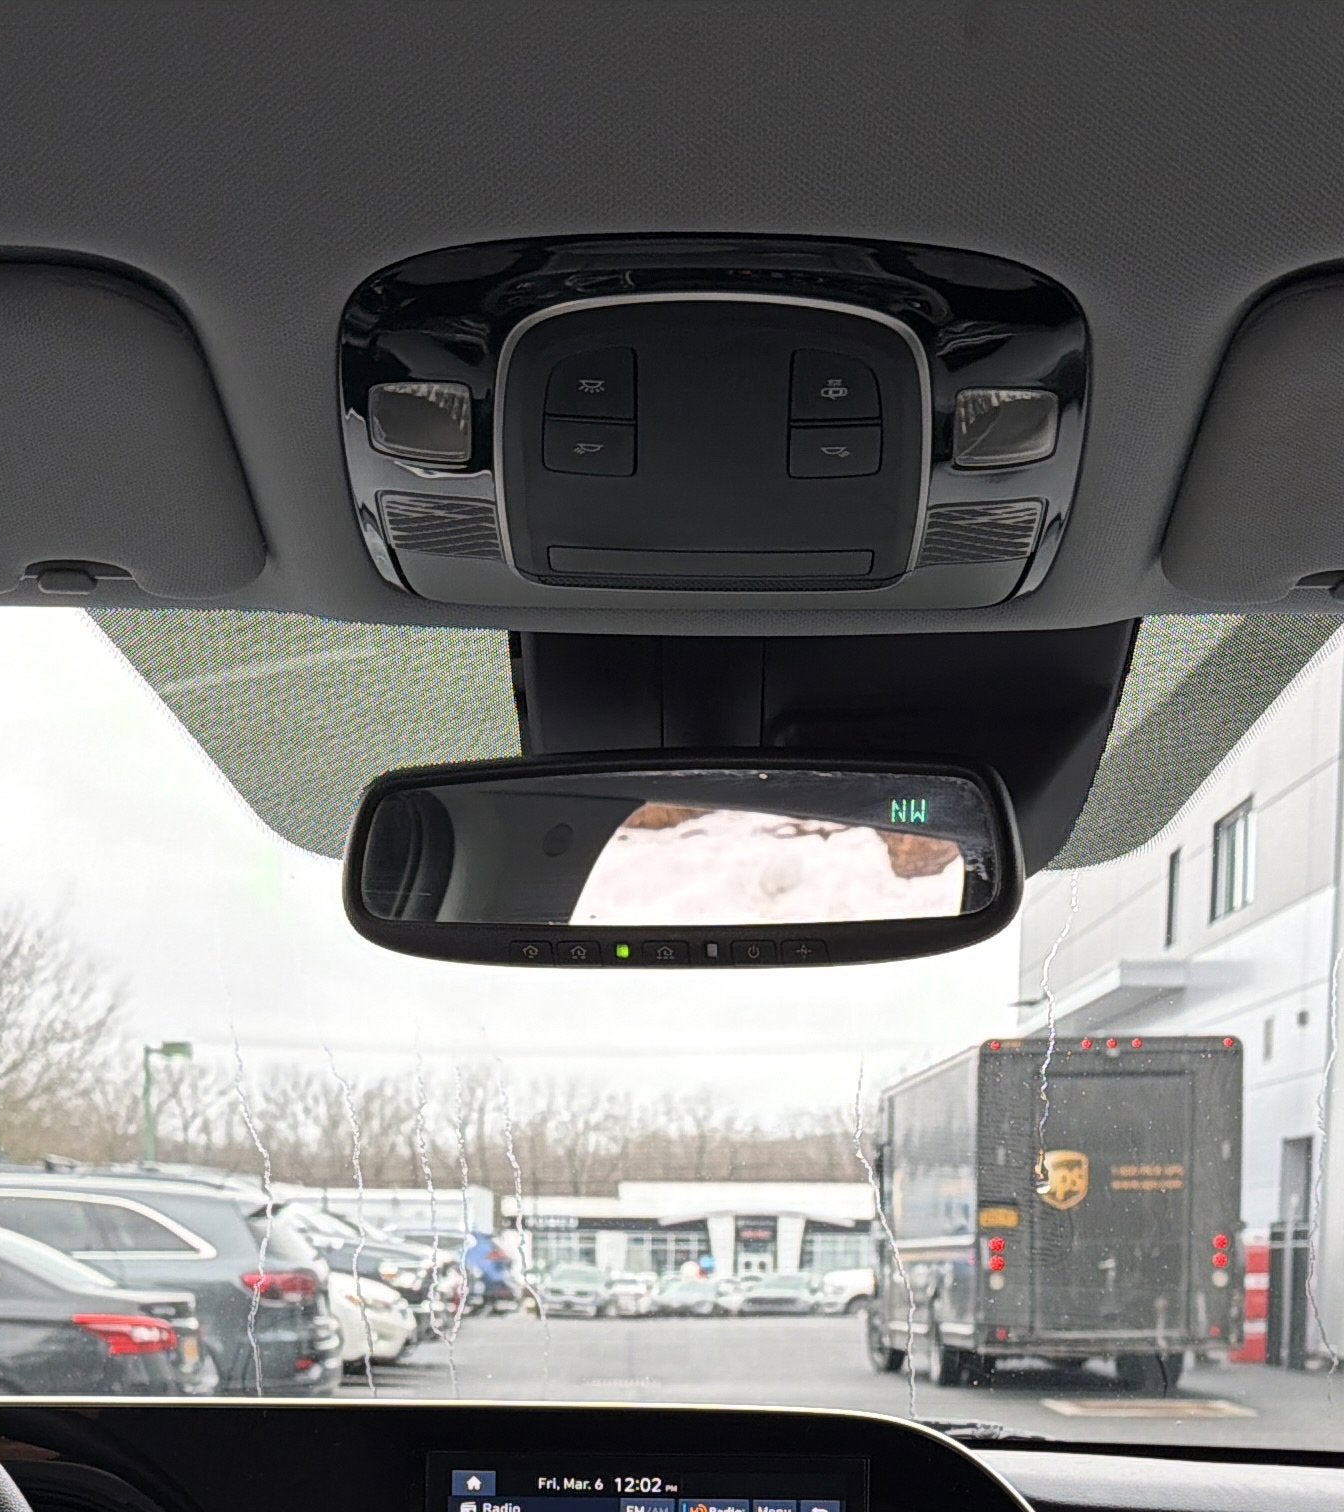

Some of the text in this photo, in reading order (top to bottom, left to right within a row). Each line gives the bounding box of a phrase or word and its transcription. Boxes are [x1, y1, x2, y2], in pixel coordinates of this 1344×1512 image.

[890, 799, 927, 823] NW
[563, 1478, 592, 1491] Mar.
[594, 1478, 604, 1491] 6
[614, 1477, 662, 1493] 12:02
[665, 1484, 678, 1492] PM
